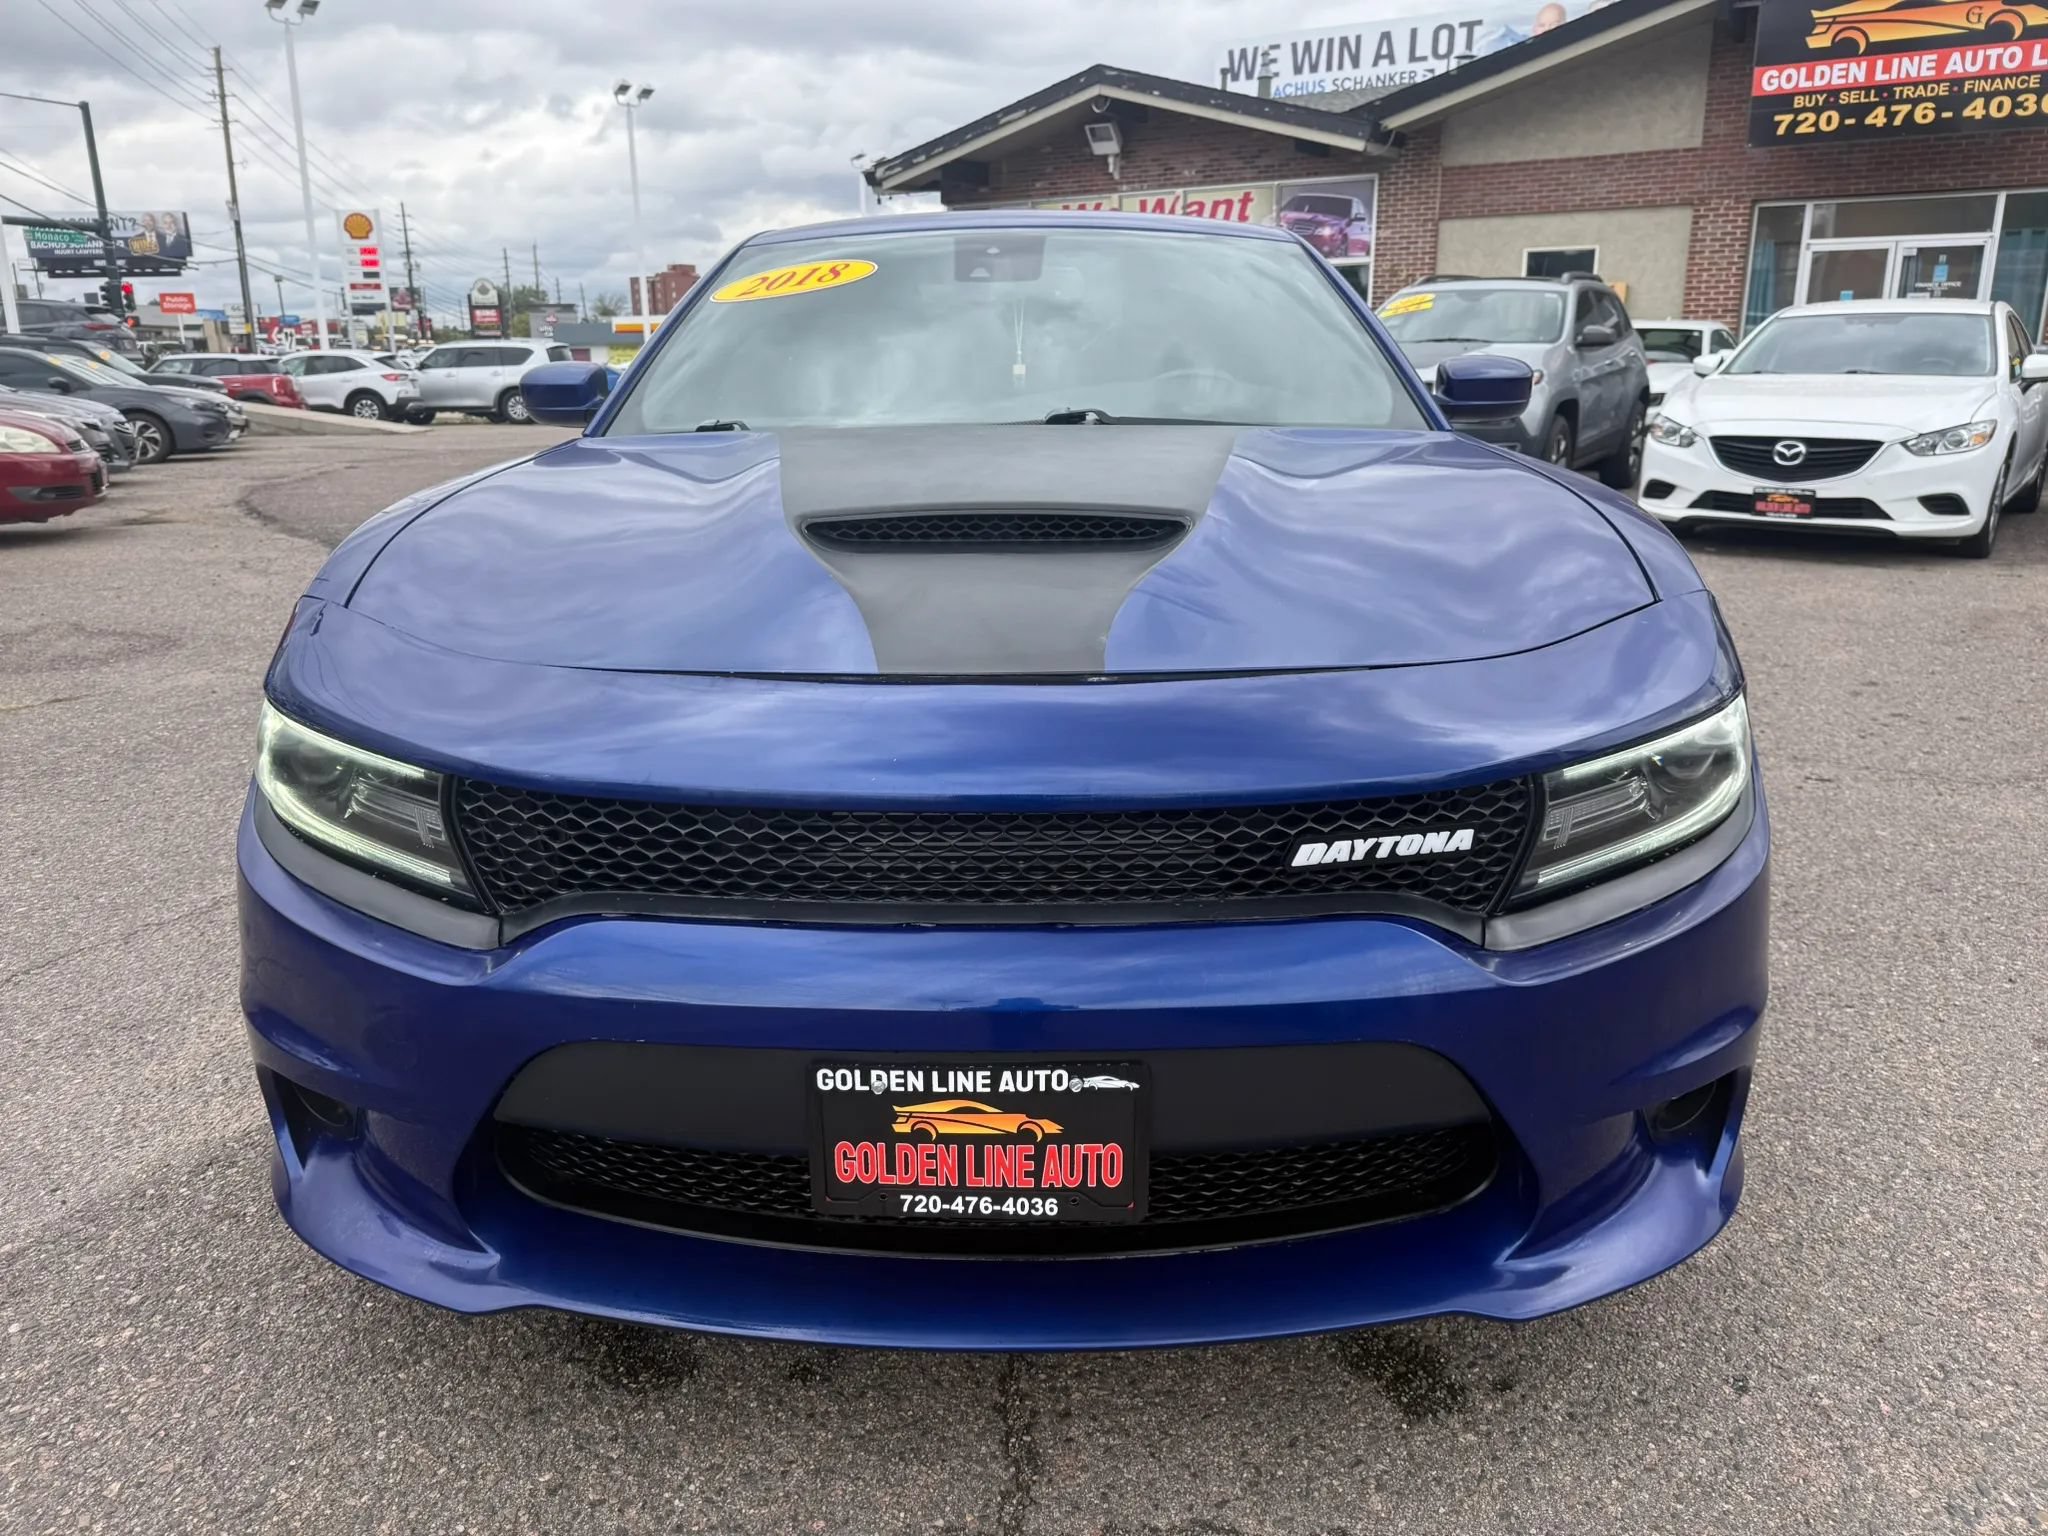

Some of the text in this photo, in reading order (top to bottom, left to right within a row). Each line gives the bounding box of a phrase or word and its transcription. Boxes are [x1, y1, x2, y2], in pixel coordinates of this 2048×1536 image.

[1228, 19, 1483, 82] WE WIN A LOT
[1273, 69, 1417, 98] ACHUS SCHANKER
[1761, 60, 1867, 92] GOLDEN
[1874, 54, 1938, 82] LINE
[1944, 45, 2022, 75] AUTO
[1793, 74, 2042, 109] BUY SELL TRADE FINANCE
[1773, 93, 2048, 136] 720-476-403
[34, 231, 70, 242] Monaco
[736, 263, 850, 297] 2018
[1291, 828, 1475, 867] DAYTONA
[816, 1068, 1069, 1093] GOLDEN LINE AUTO
[834, 1141, 1123, 1188] GOLDEN LINE AUTO
[900, 1195, 1059, 1216] 720-476-4036
